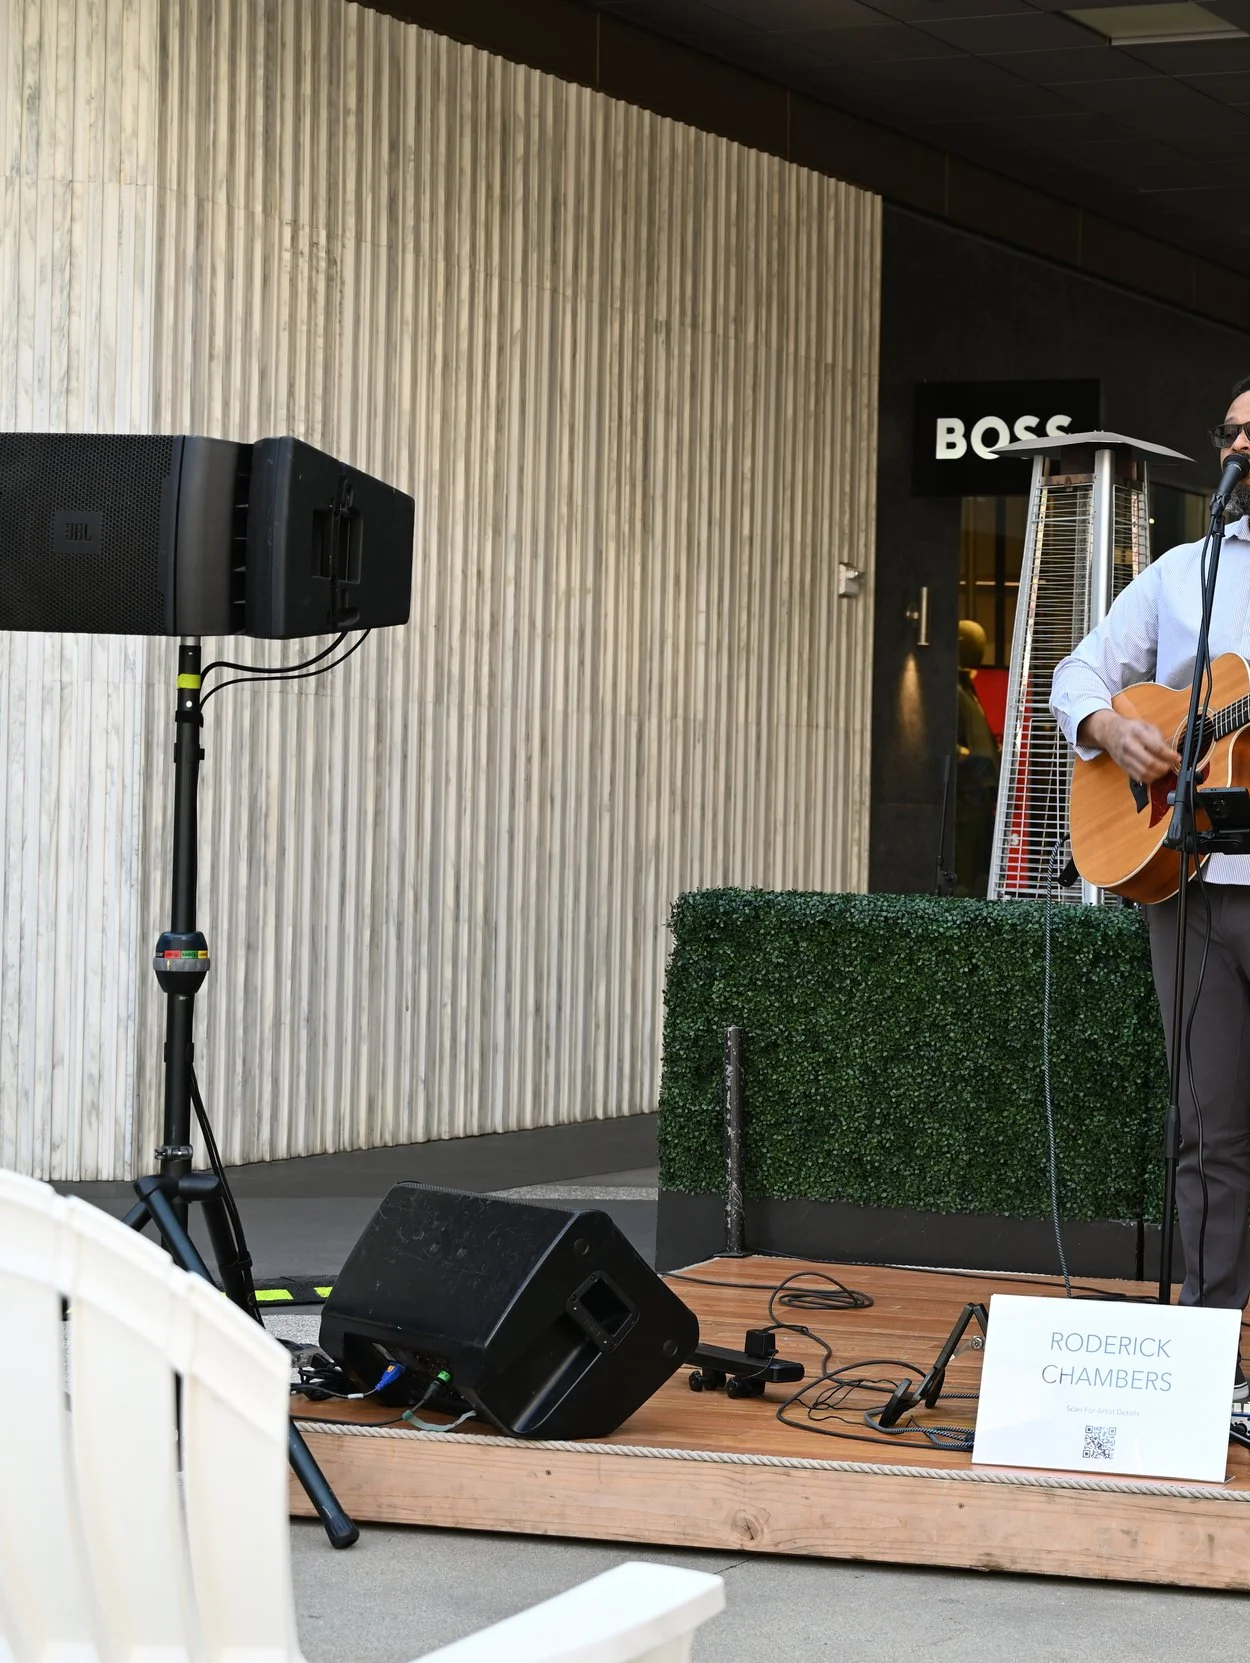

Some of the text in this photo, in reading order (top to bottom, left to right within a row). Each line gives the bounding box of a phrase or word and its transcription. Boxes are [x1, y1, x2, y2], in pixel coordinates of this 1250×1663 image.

[64, 522, 93, 541] JBL
[1050, 1331, 1172, 1358] RODERICK
[1041, 1364, 1173, 1392] CHAMBERS
